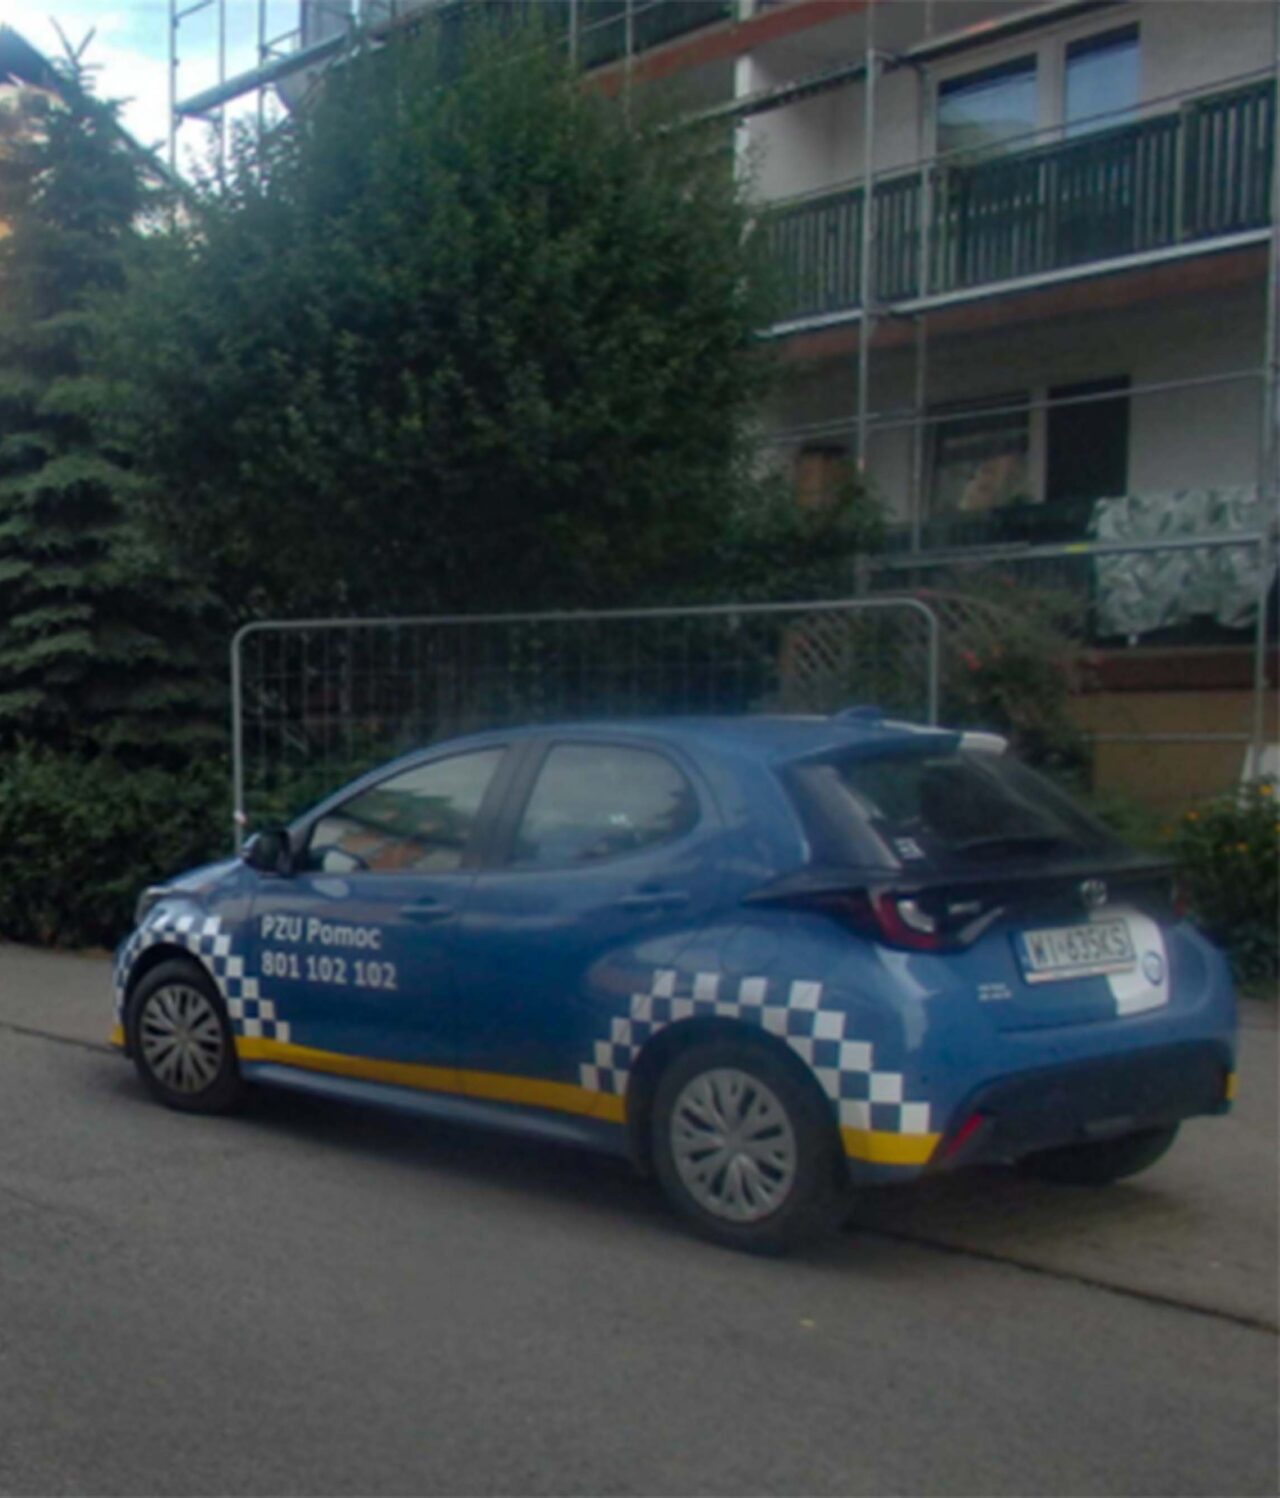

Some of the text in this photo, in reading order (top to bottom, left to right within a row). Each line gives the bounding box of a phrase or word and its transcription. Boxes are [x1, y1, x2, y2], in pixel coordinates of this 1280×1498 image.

[261, 914, 381, 950] PZU Pomoc
[261, 951, 397, 990] 801 102 102
